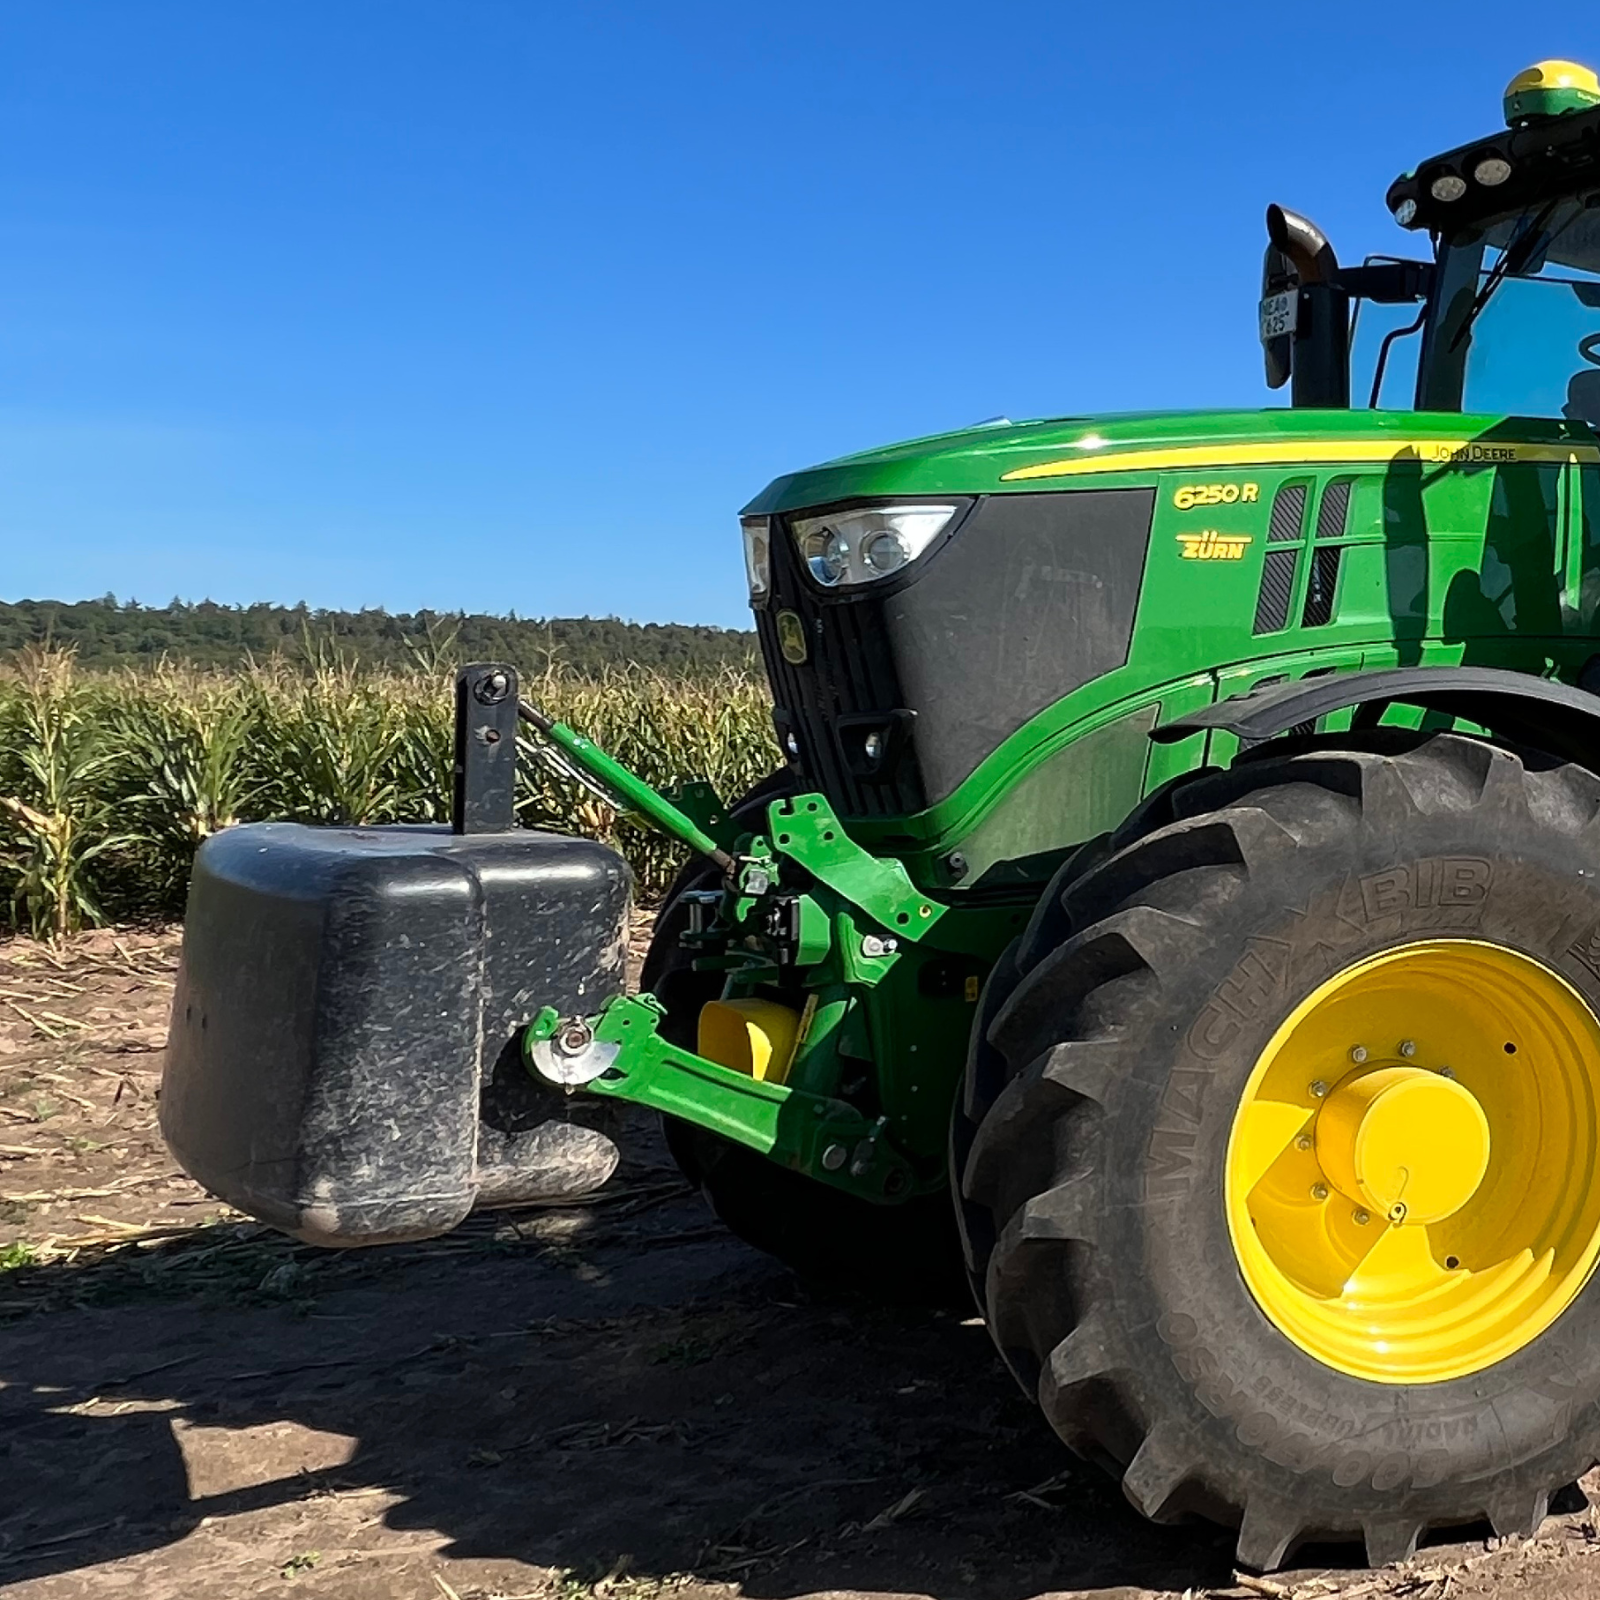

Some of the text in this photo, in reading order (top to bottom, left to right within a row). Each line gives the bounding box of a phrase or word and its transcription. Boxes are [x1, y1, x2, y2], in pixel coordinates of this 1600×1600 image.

[1432, 444, 1517, 460] JOHN DEERE
[1174, 482, 1259, 510] 6250 R
[1181, 530, 1245, 560] ZÜRN
